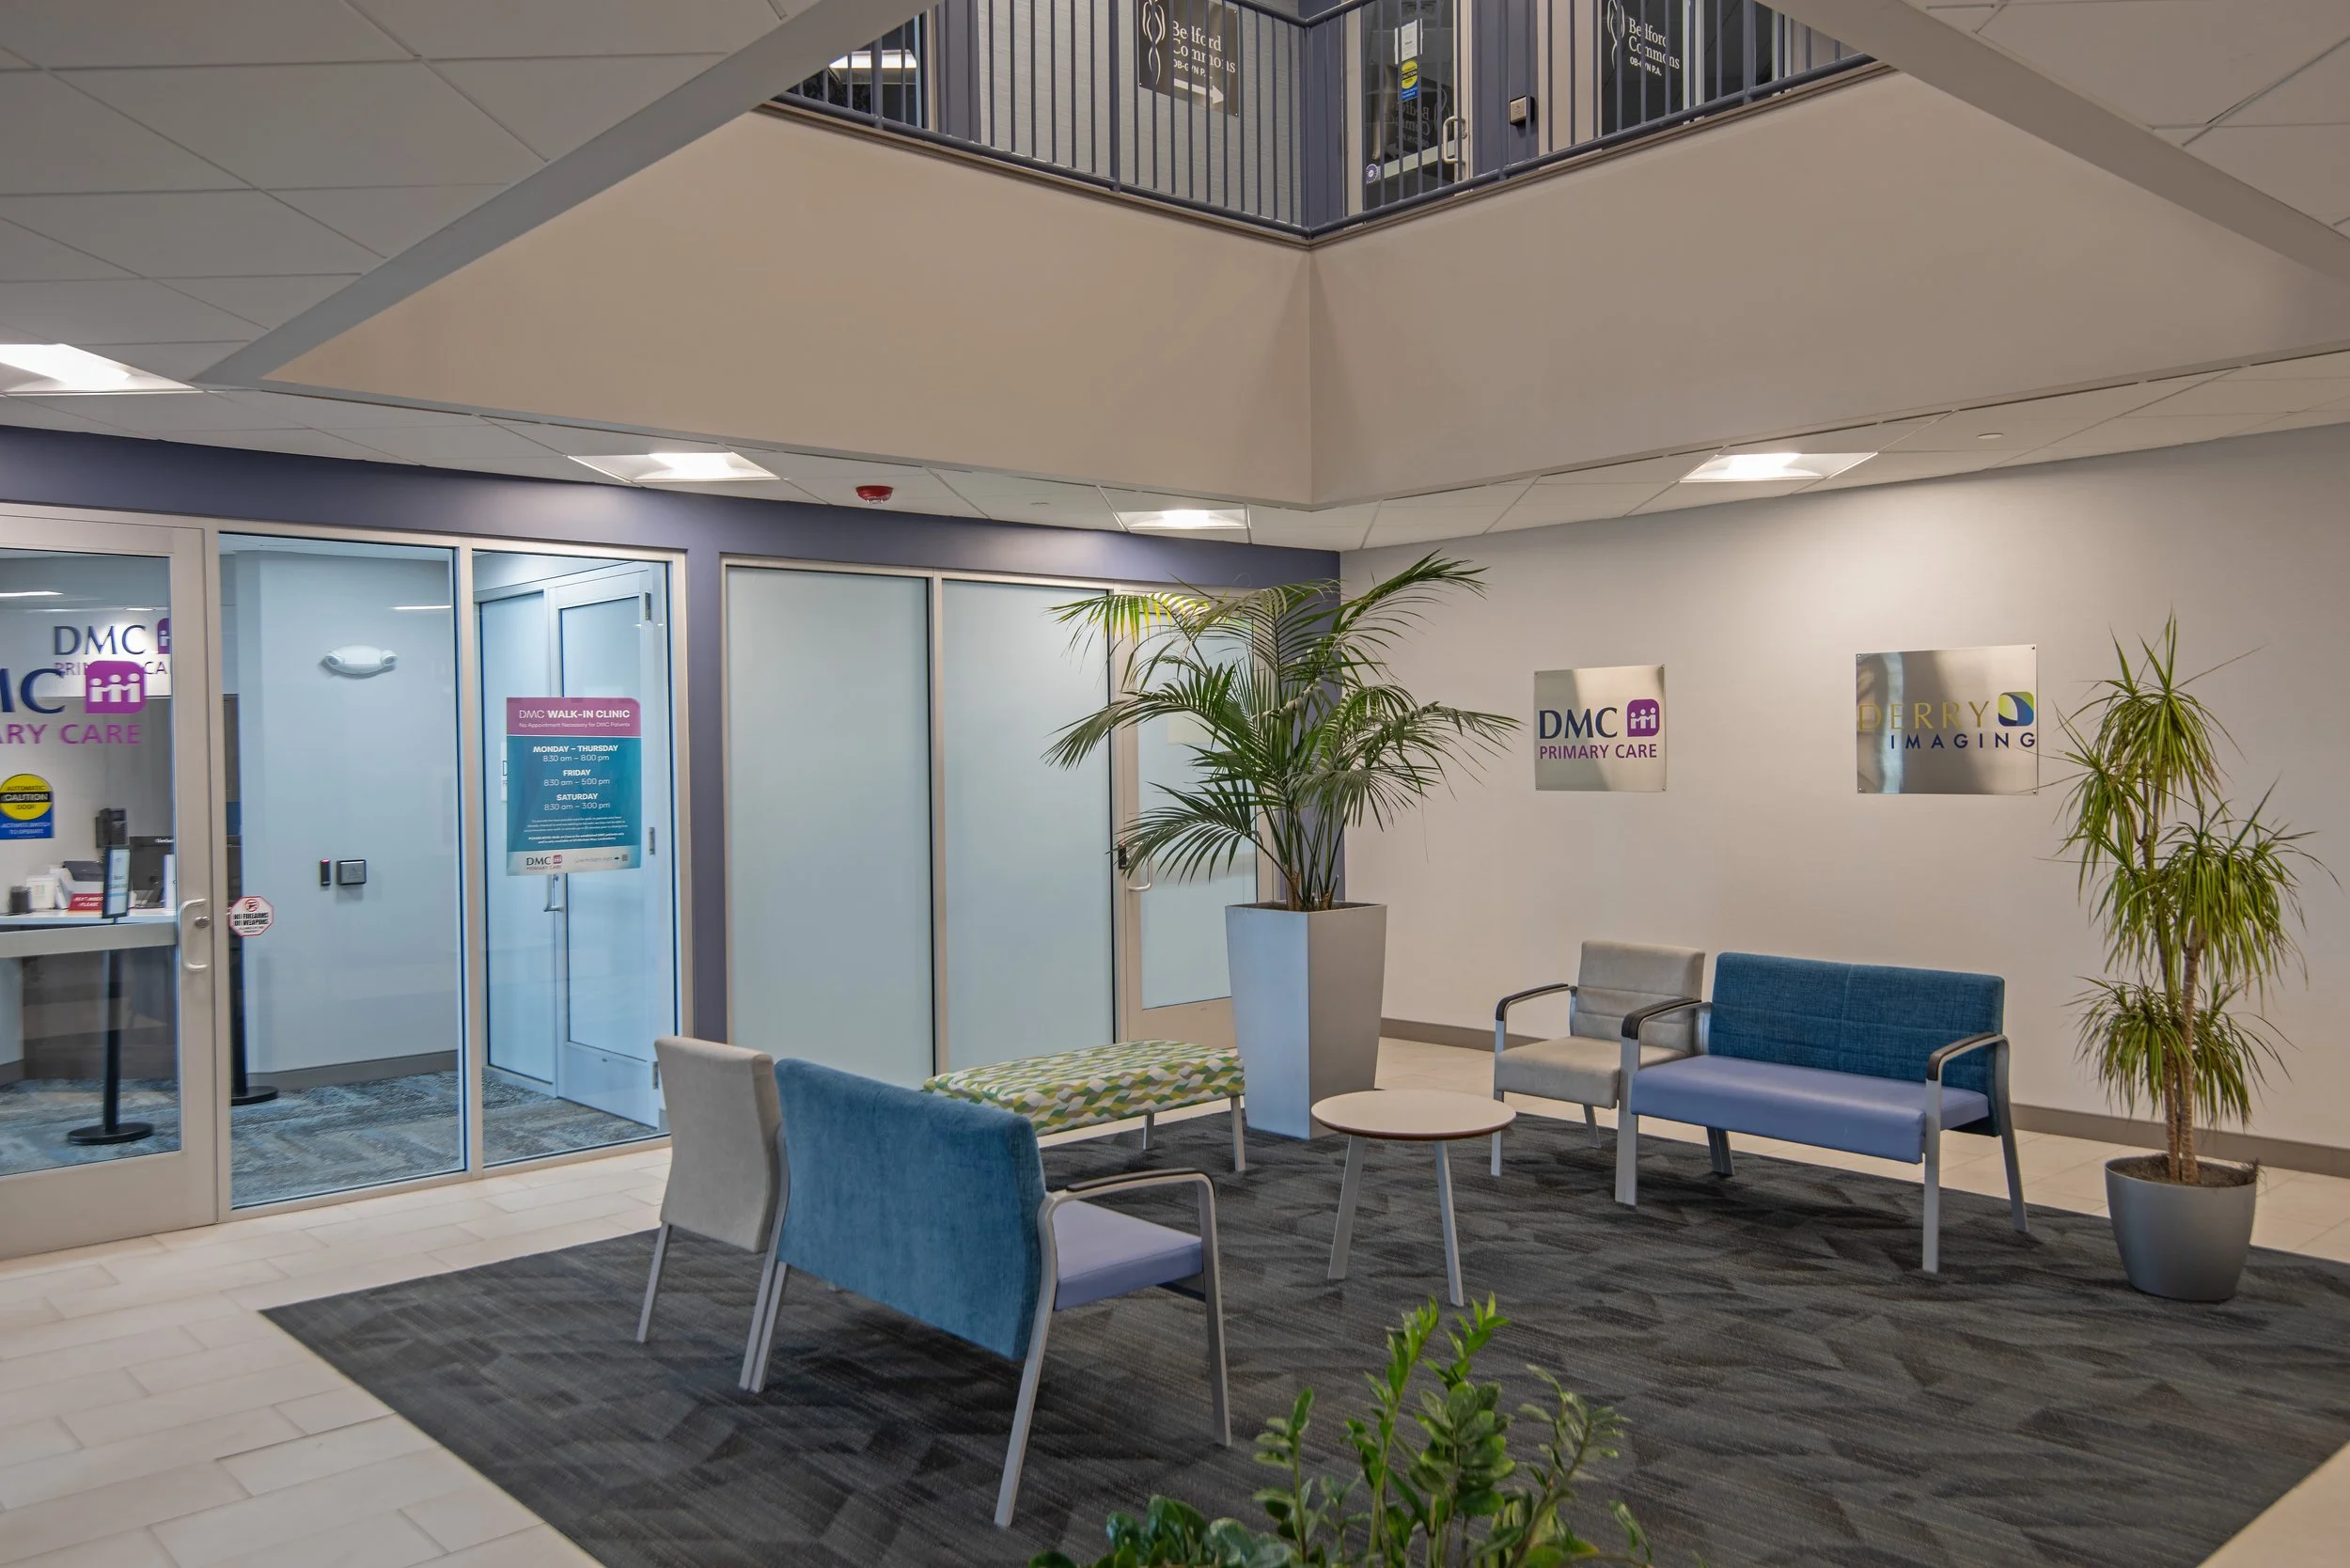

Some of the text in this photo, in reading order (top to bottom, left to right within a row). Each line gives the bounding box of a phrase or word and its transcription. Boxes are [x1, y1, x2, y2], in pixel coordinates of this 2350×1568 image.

[54, 624, 147, 656] DMC
[144, 661, 169, 675] CA
[519, 710, 631, 719] DMC WALK-IN CLINIC
[1858, 700, 1990, 730] DERRY
[1539, 707, 1618, 739] DMC
[60, 723, 142, 745] CARE
[1890, 732, 2035, 749] IMAGING
[1540, 744, 1657, 760] PRIMARY CARE
[5, 793, 49, 802] CAUTION
[556, 792, 599, 801] SATURDAY
[526, 856, 552, 866] DMC
